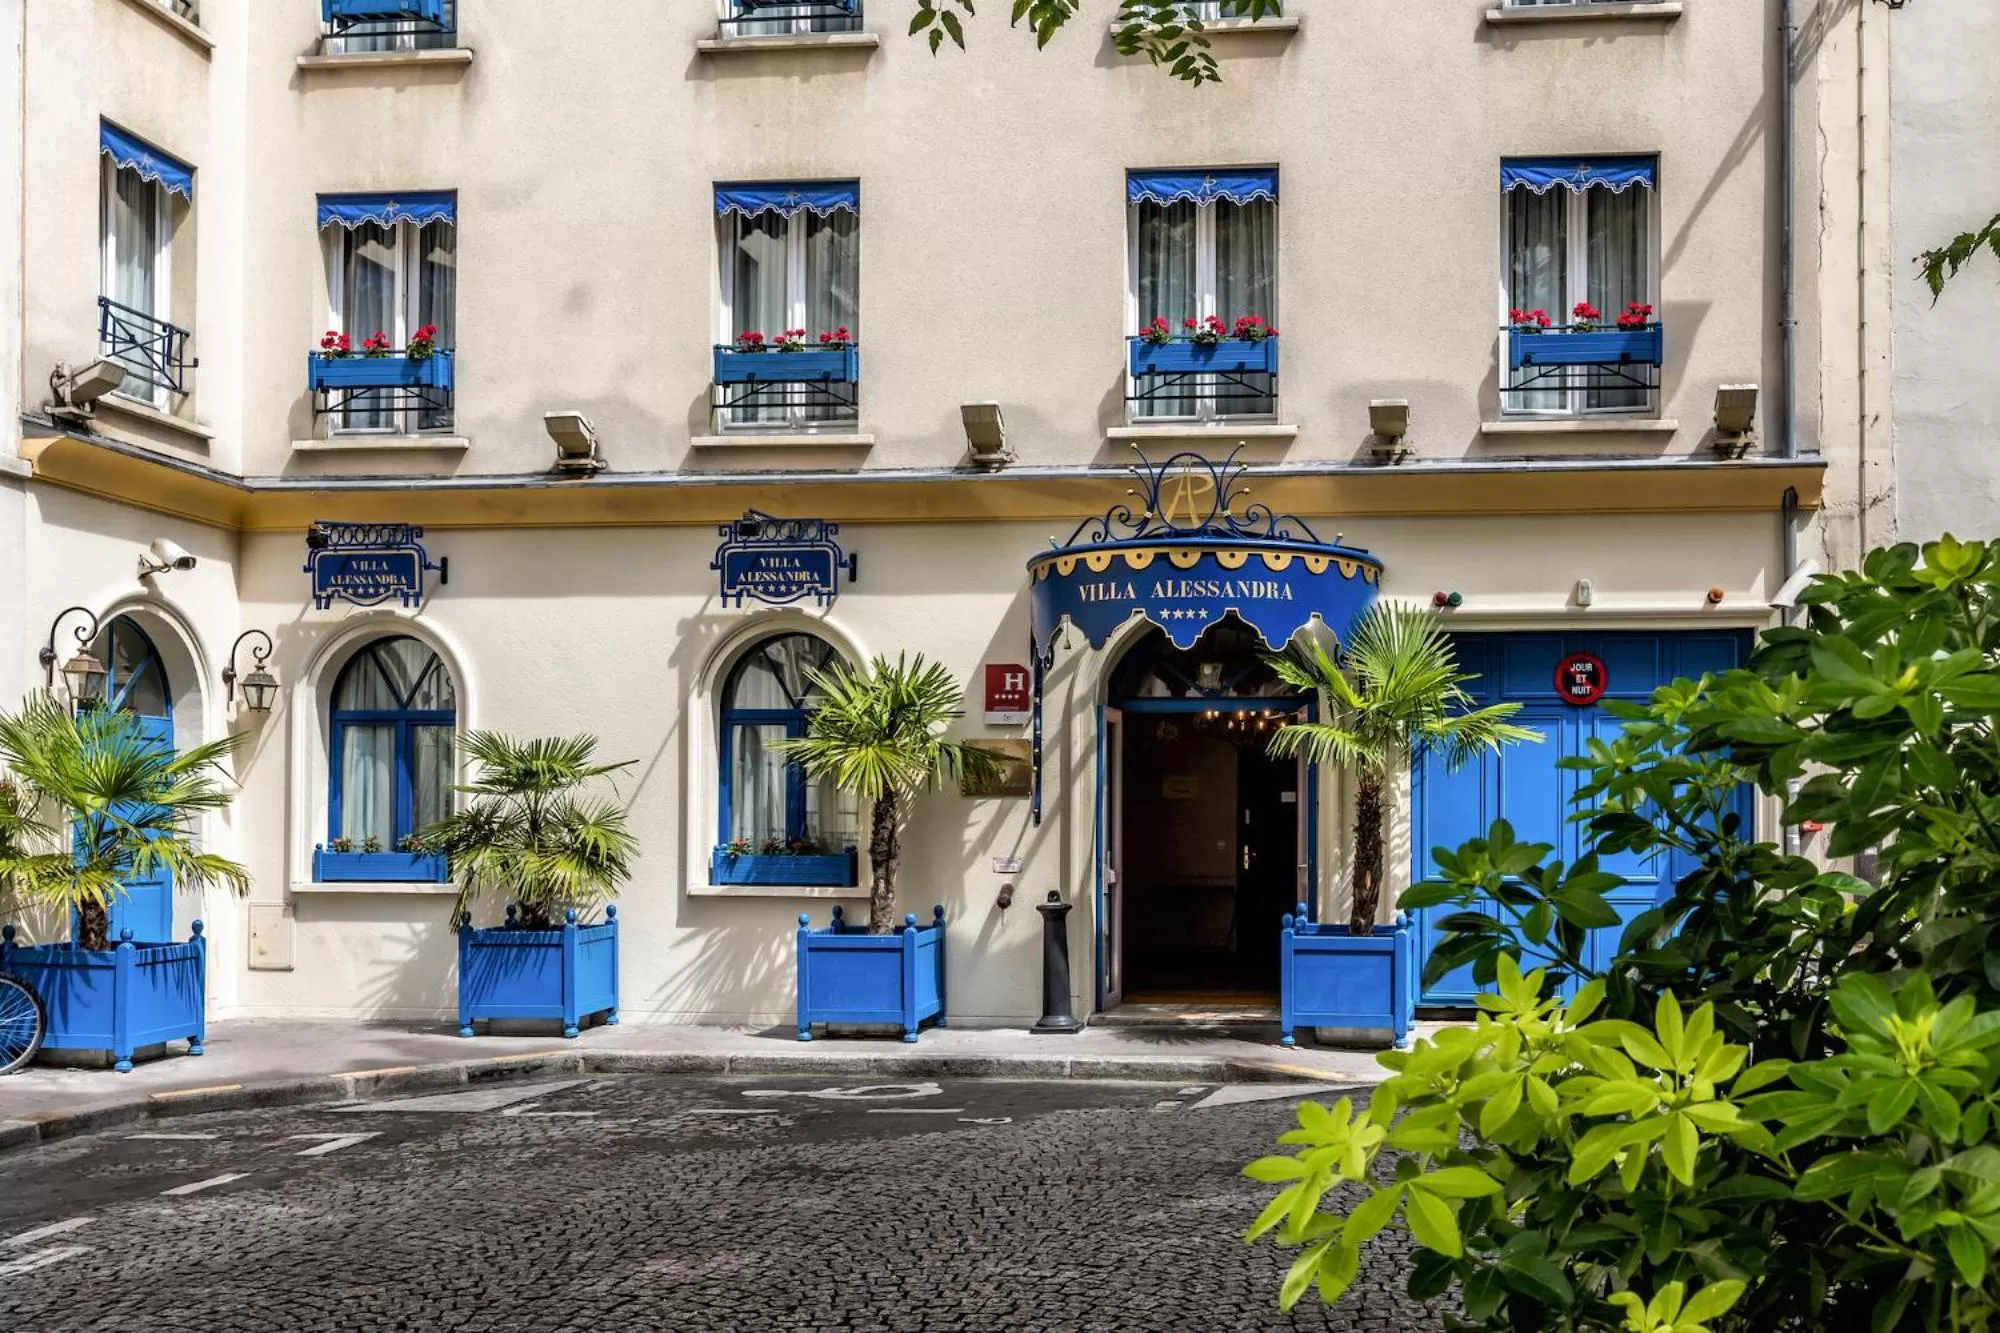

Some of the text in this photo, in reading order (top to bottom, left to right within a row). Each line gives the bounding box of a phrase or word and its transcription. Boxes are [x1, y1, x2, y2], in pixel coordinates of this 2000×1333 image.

[351, 560, 389, 571] VILLA
[759, 557, 801, 568] VILLA
[330, 575, 407, 585] ALESSANDRA
[738, 571, 820, 582] ALESSANDRA
[1079, 579, 1293, 602] VILLA ALESSANDRA
[1570, 662, 1593, 672] JOUR
[1003, 672, 1025, 691] H
[1575, 673, 1587, 684] ET
[1571, 685, 1592, 695] NUIT
